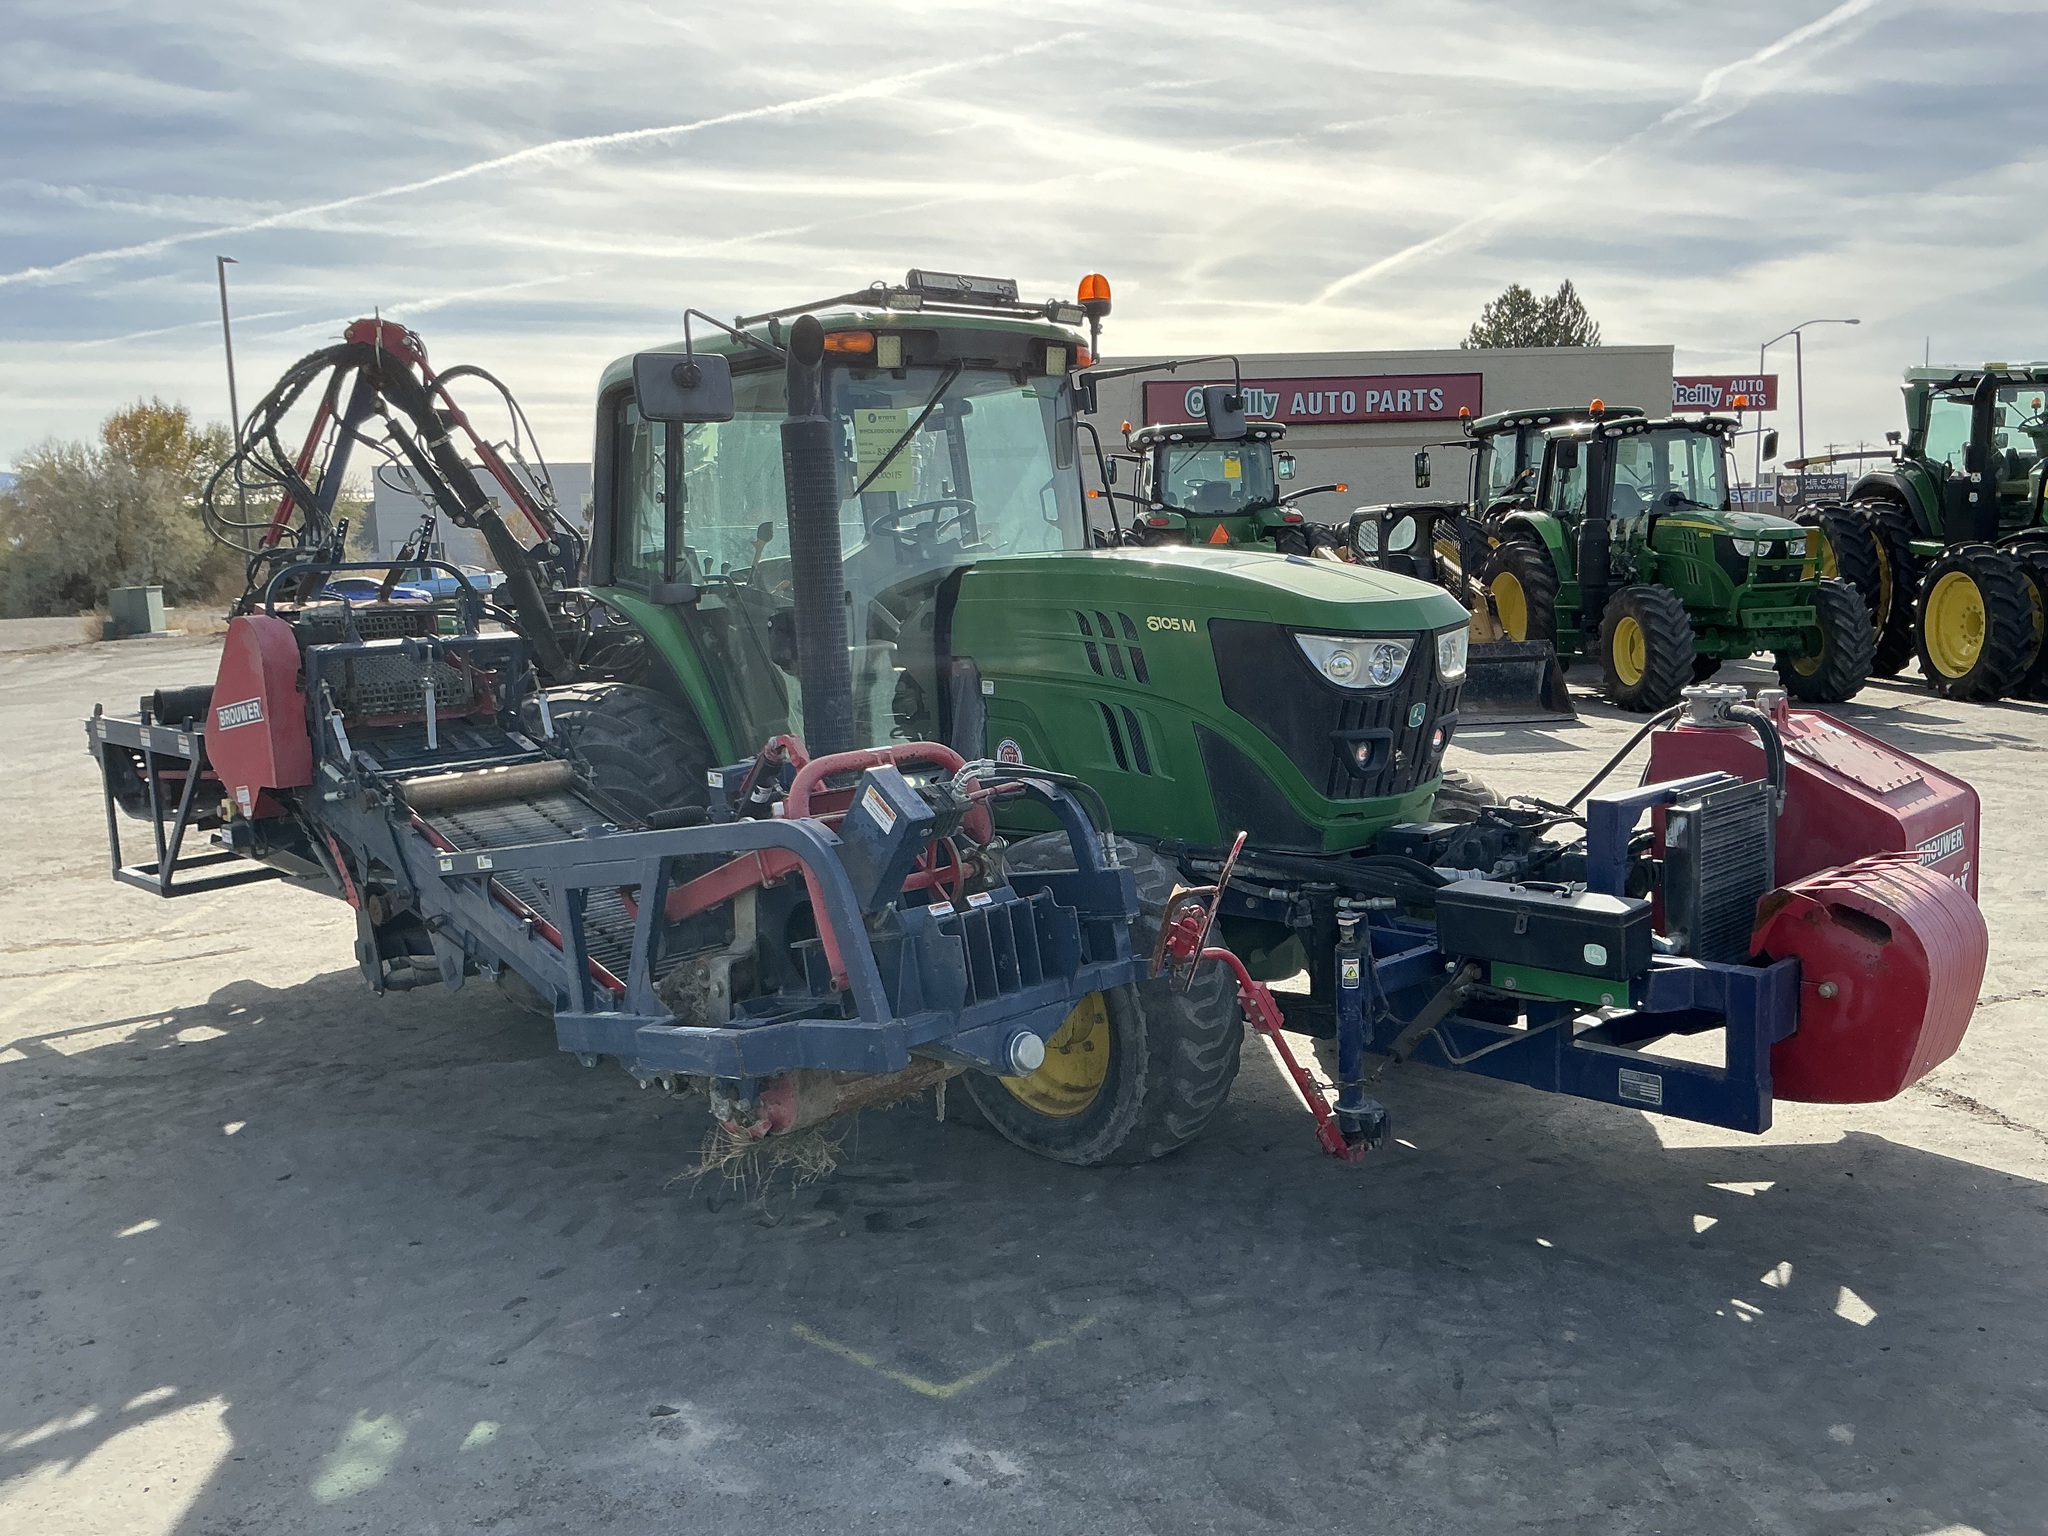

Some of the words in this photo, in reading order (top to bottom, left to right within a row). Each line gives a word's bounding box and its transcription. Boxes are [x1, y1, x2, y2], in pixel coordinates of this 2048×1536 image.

[1673, 381, 1722, 407] 'Reilly
[1730, 380, 1764, 392] AUTO
[1290, 391, 1356, 415] AUTO
[1366, 388, 1444, 413] PARTS
[1725, 394, 1766, 406] PTS
[1820, 477, 1845, 485] CAGE
[219, 701, 261, 727] BROUWER
[1918, 828, 1963, 867] BROUWER
